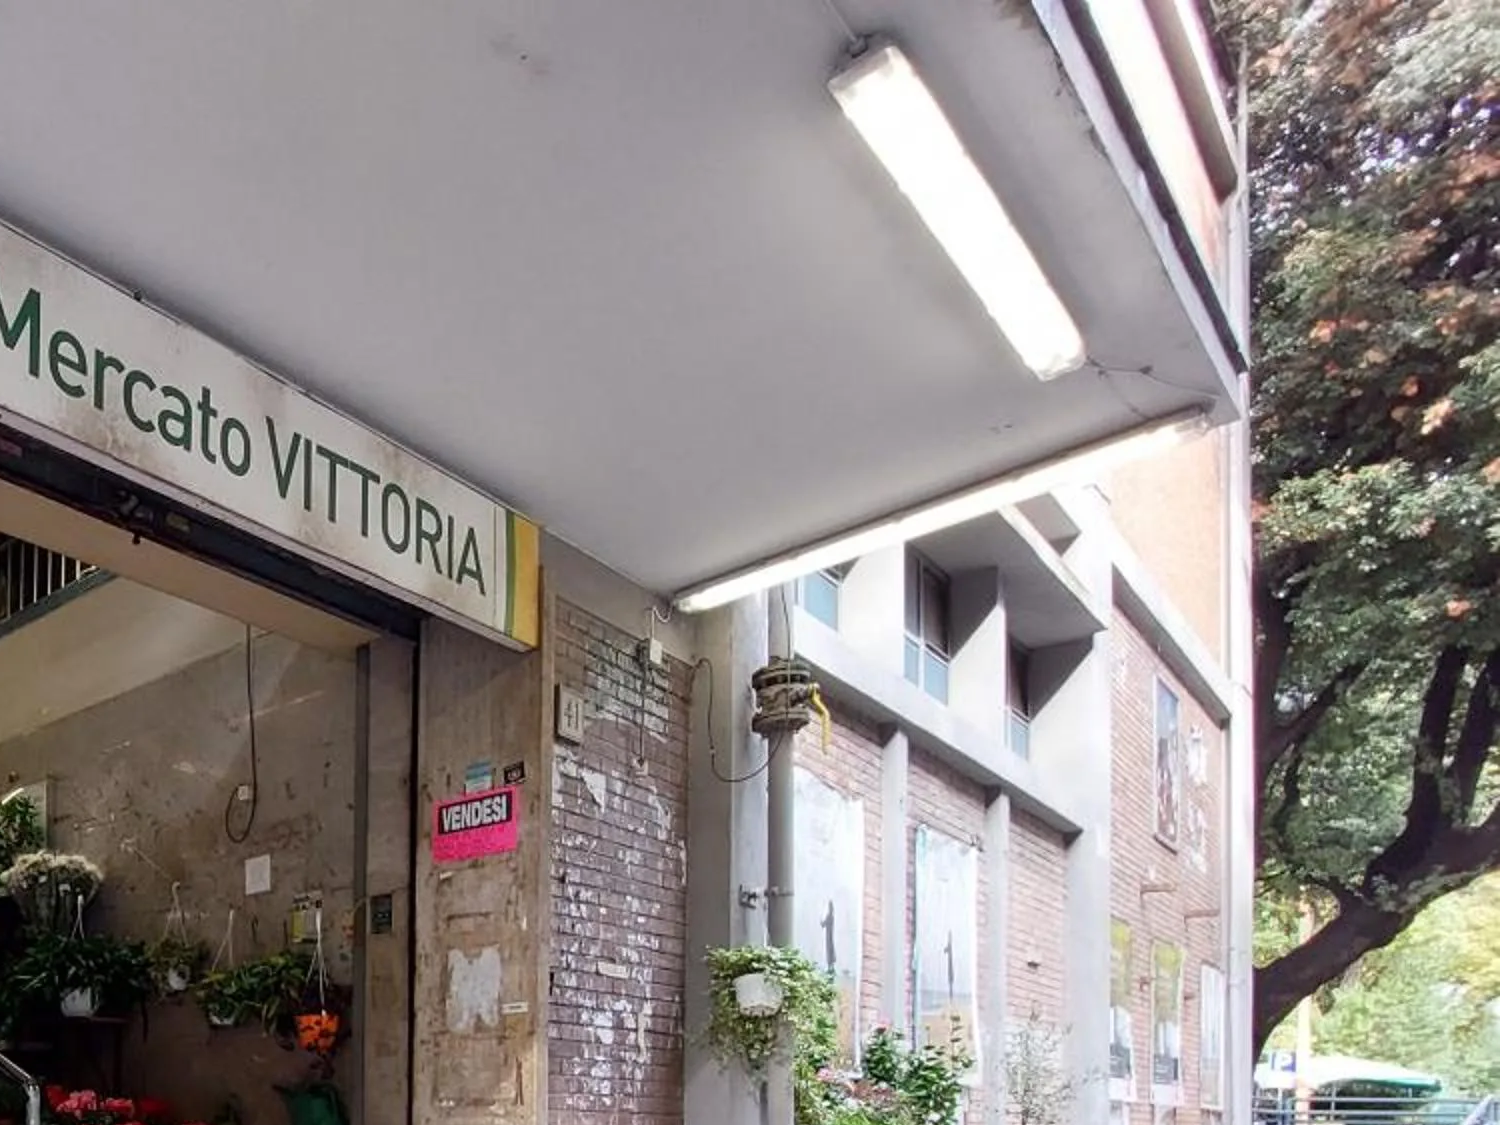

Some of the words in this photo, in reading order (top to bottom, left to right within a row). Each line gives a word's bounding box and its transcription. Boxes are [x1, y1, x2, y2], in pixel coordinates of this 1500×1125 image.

[266, 415, 486, 597] VITTORIA
[442, 794, 507, 832] VENDESI
[1274, 1053, 1292, 1070] P
